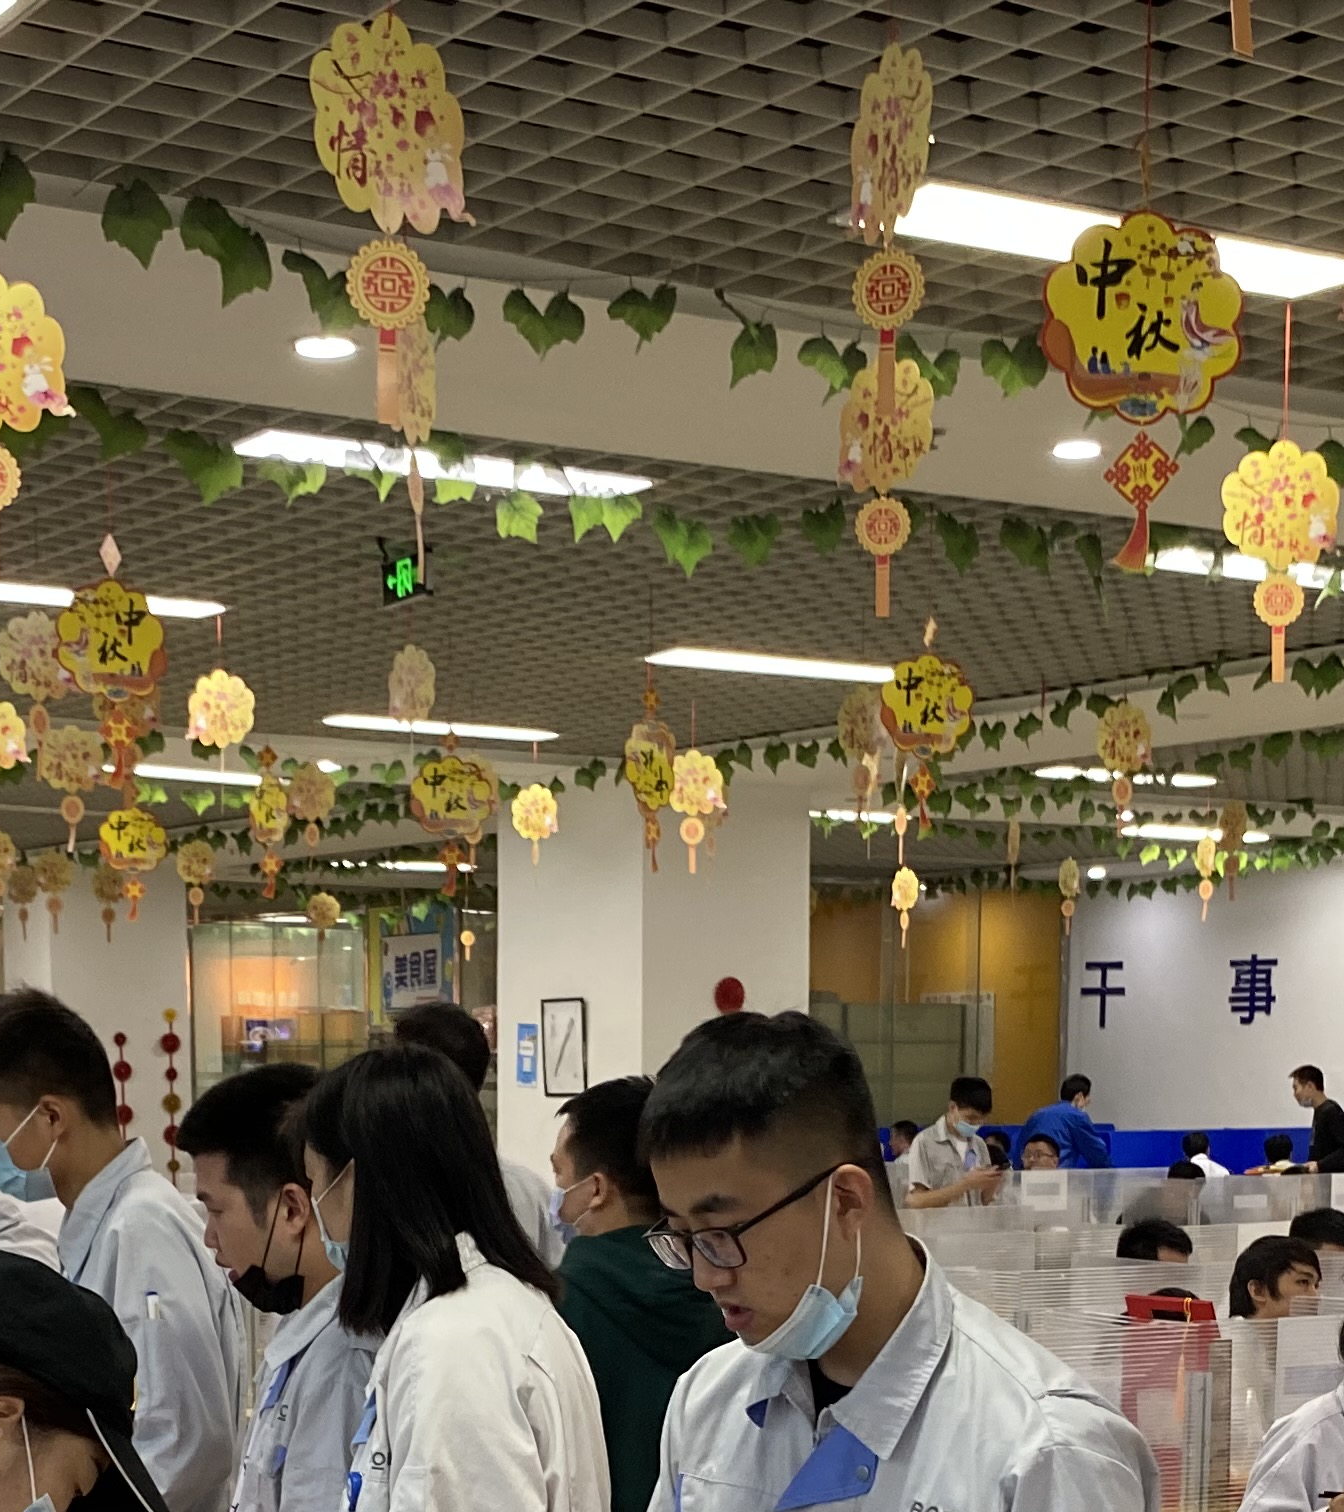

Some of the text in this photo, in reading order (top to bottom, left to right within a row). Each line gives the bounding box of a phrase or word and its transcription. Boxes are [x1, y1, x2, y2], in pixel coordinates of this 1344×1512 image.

[1075, 239, 1181, 361] 中秋
[98, 598, 145, 665] 中秋
[895, 667, 945, 726] 中秋
[423, 767, 468, 812] 中秋
